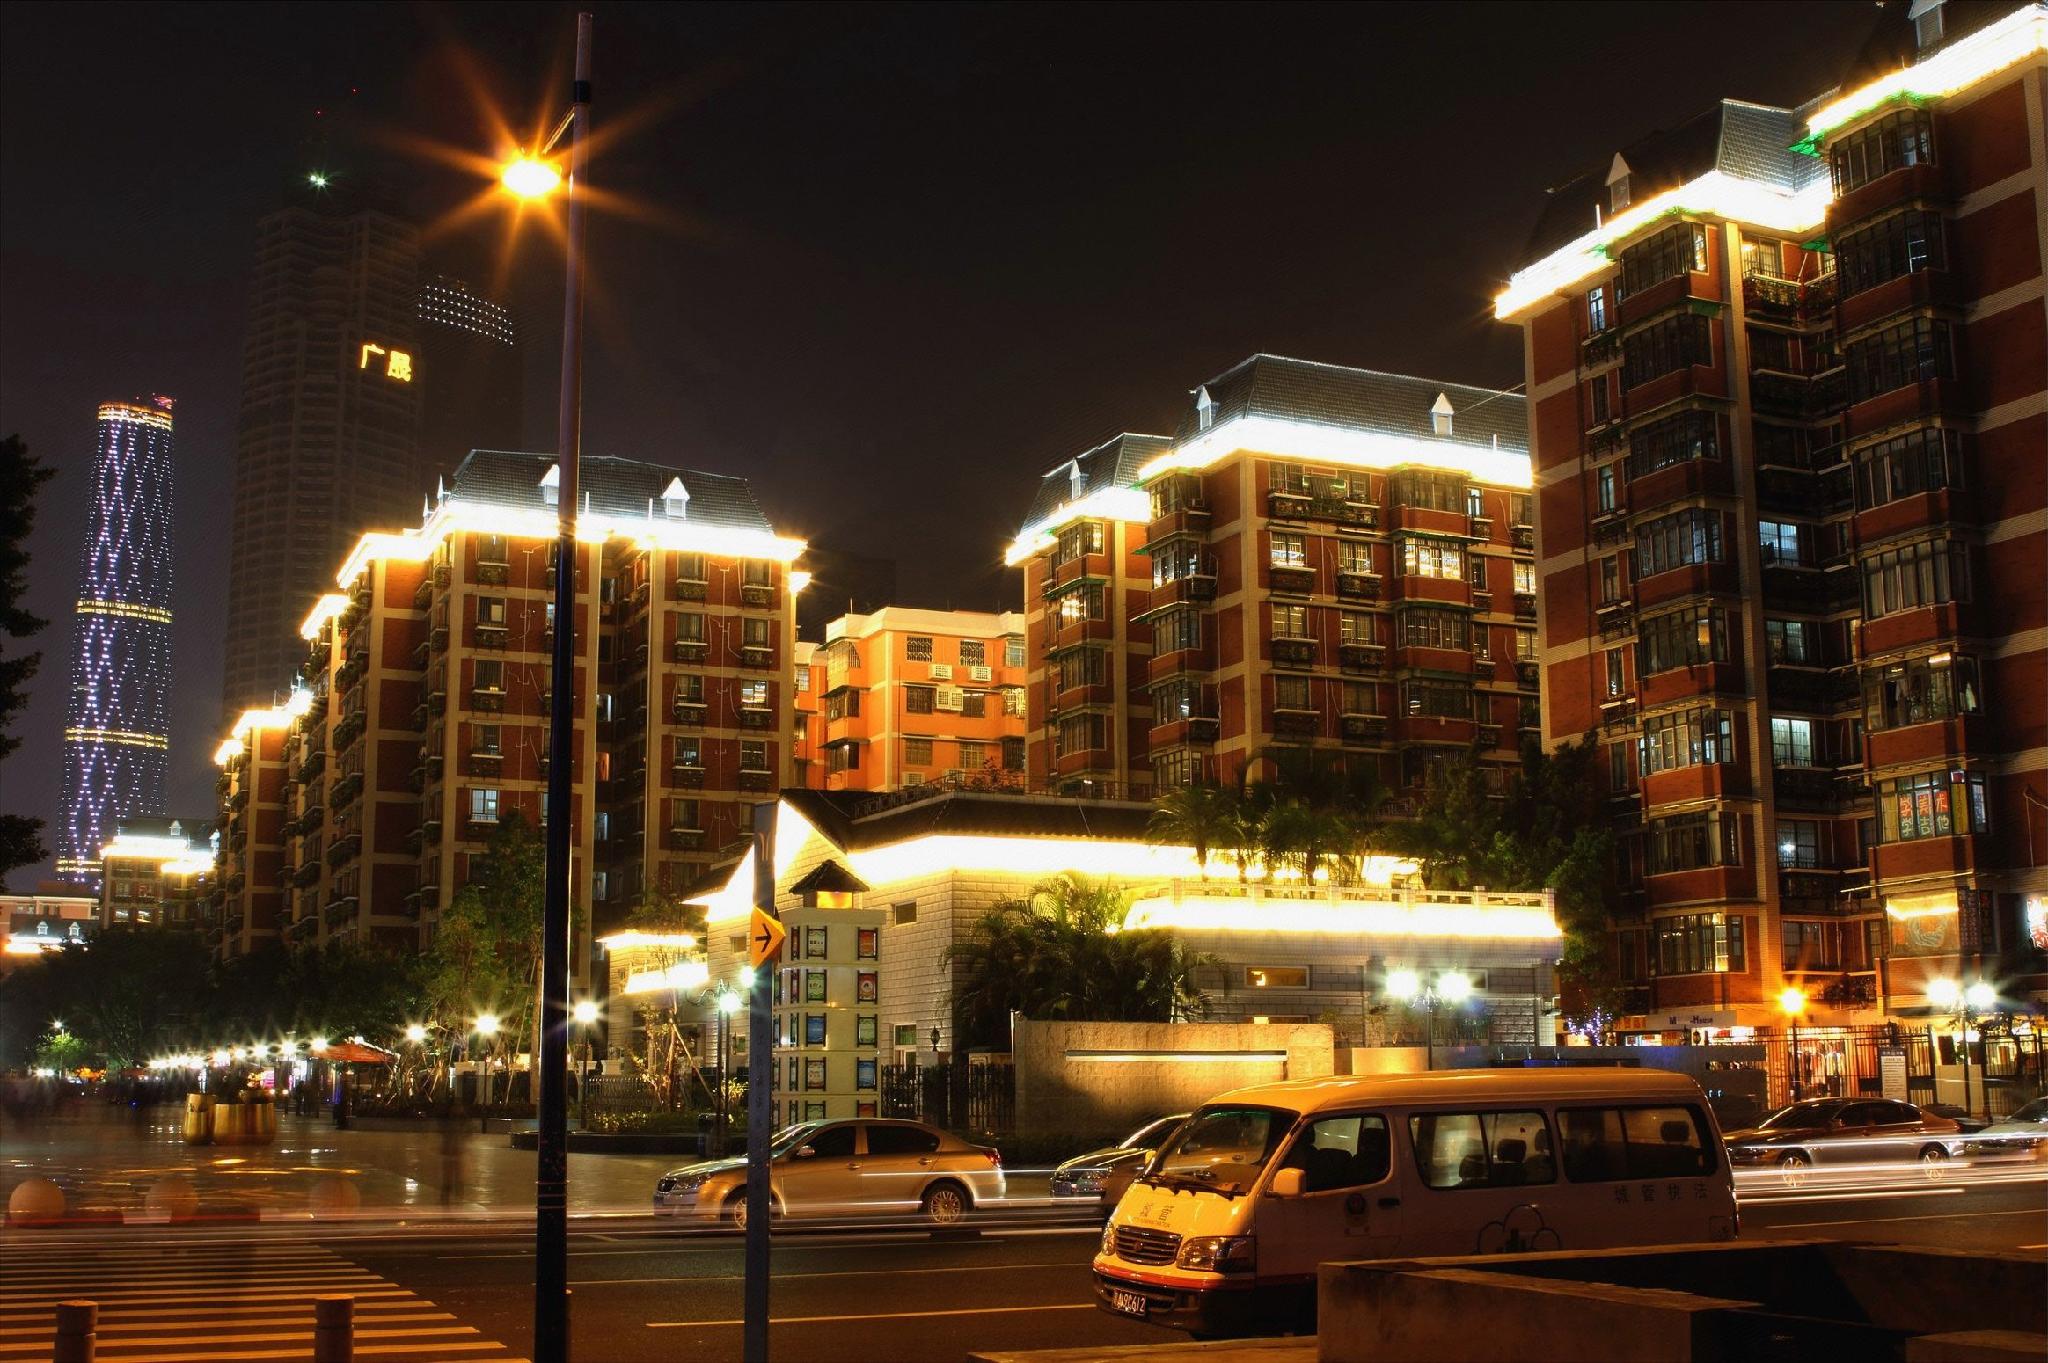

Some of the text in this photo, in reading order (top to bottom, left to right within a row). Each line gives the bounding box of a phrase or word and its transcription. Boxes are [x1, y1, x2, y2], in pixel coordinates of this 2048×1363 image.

[1901, 814, 1950, 837] 学吉他
[1613, 1182, 1708, 1204] 城管执法
